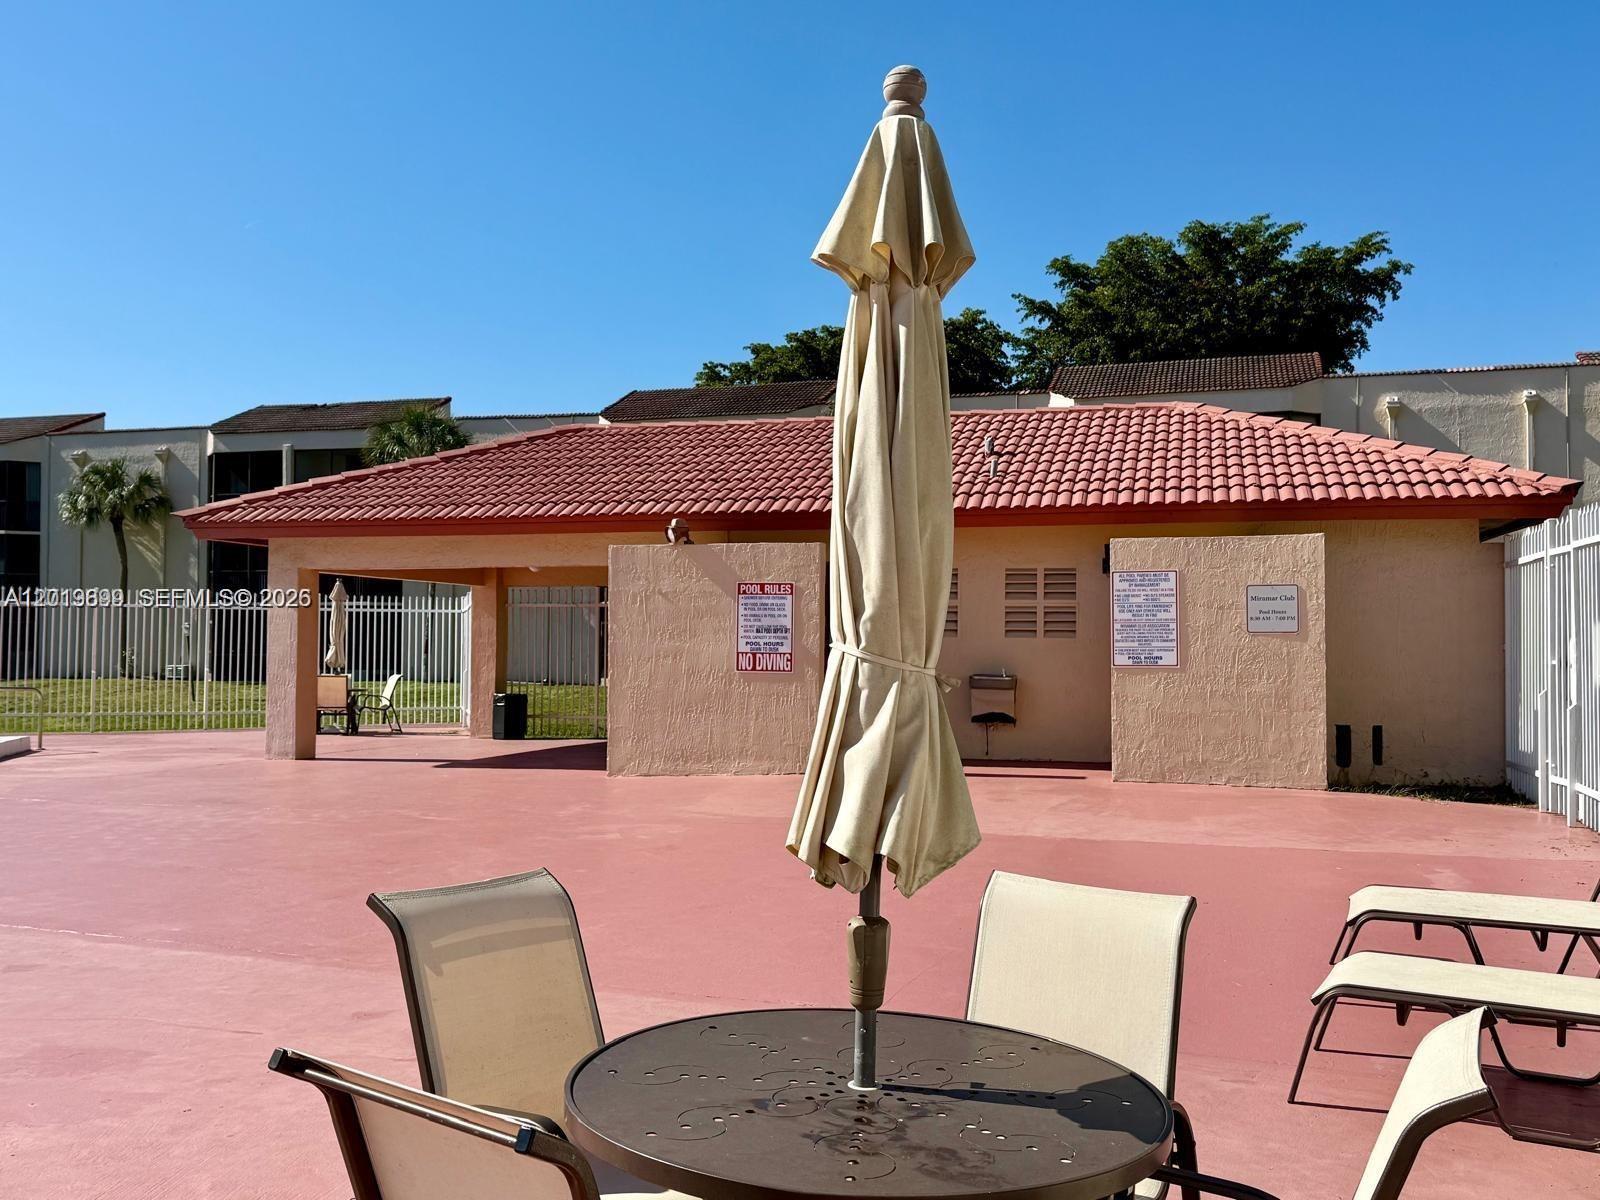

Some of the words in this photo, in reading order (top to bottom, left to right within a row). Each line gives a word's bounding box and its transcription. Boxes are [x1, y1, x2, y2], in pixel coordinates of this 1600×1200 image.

[740, 585, 762, 594] POOL
[765, 585, 791, 594] RULES
[738, 653, 753, 670] NO
[756, 654, 791, 670] DIVING
